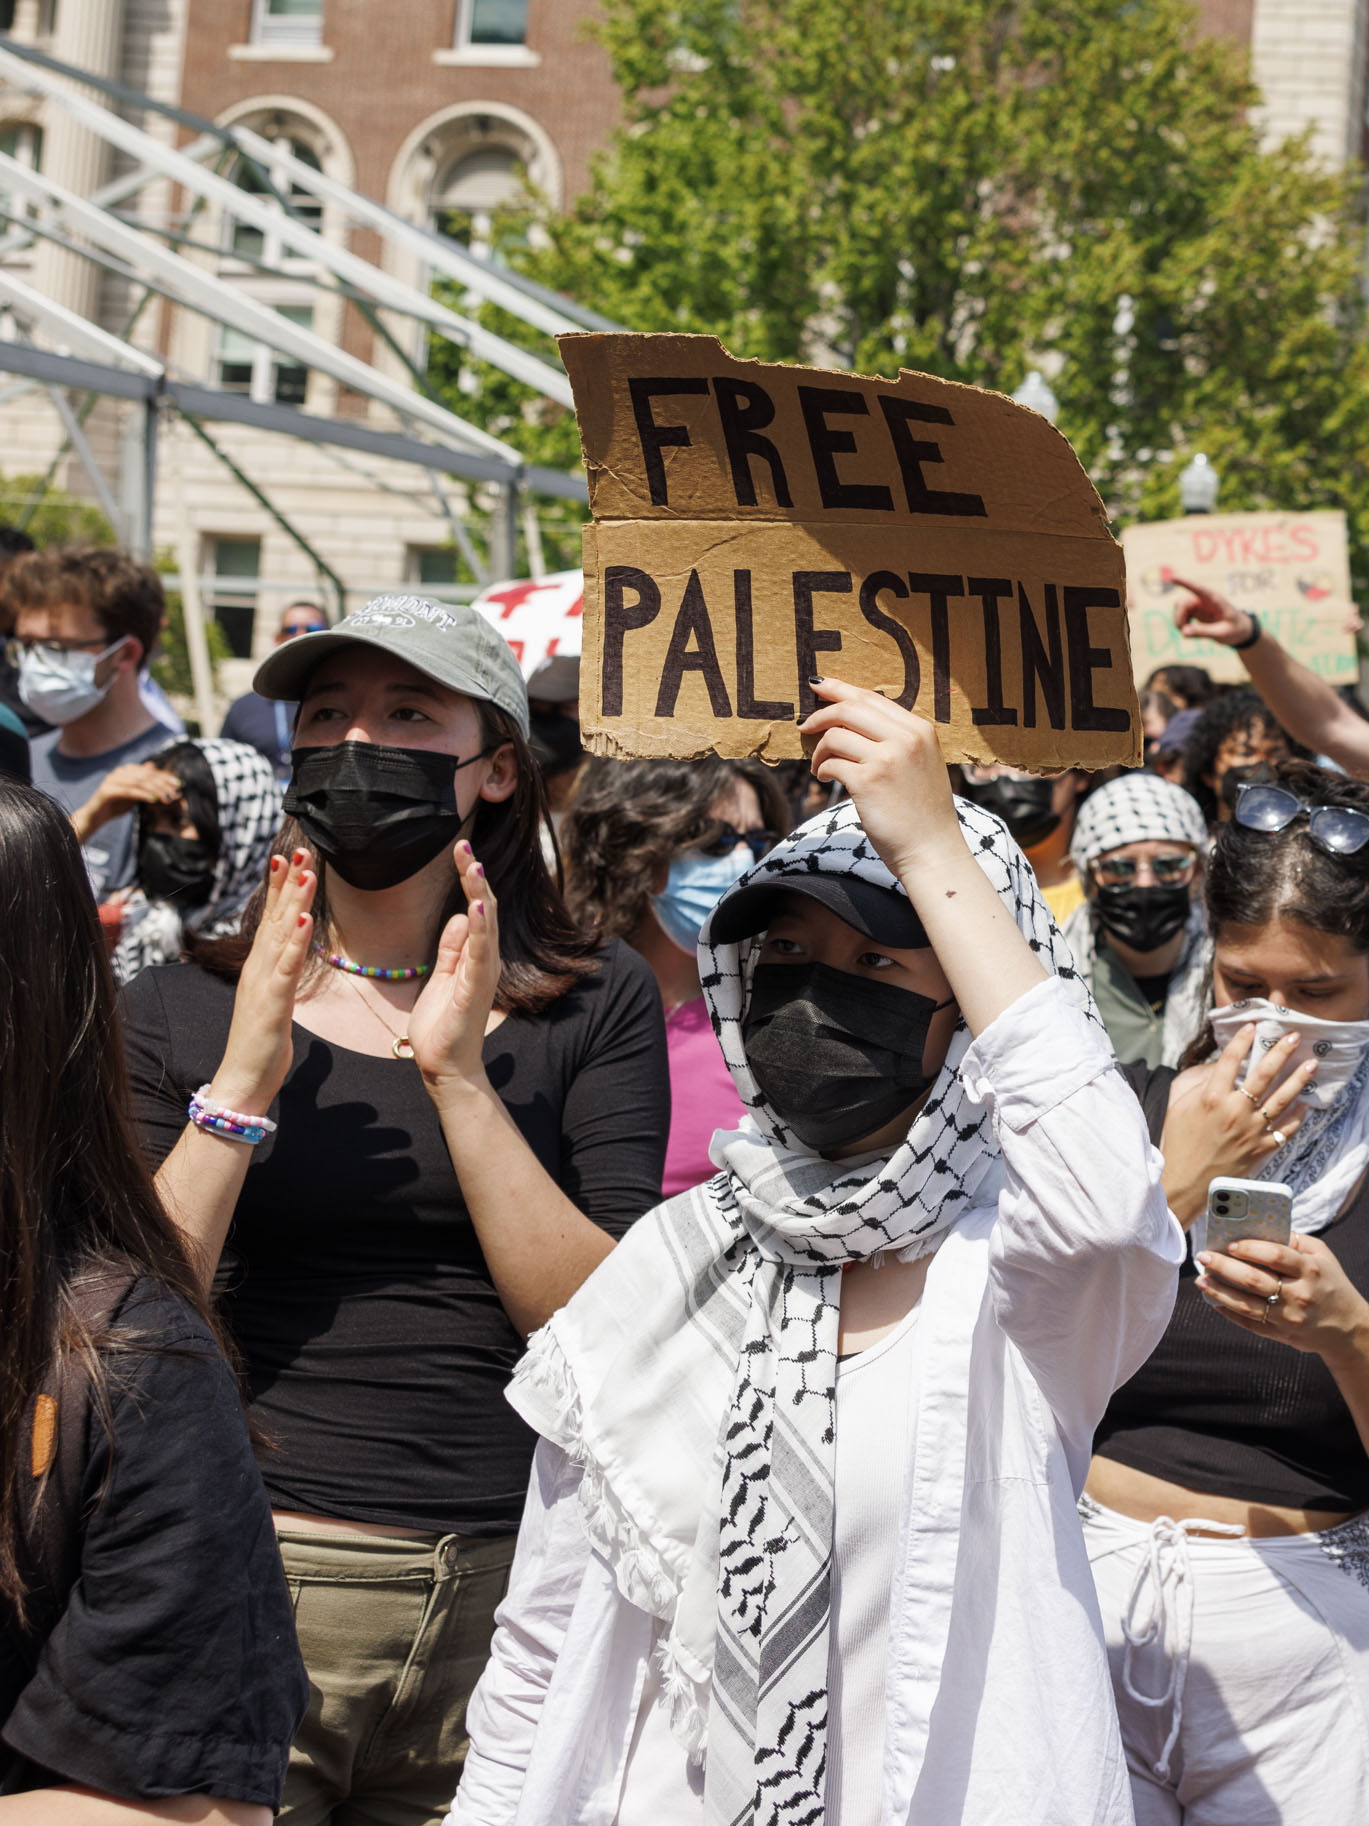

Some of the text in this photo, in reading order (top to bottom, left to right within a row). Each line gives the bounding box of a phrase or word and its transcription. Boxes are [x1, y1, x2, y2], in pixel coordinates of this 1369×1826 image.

[627, 376, 988, 517] FREE
[1190, 522, 1321, 565] DYKES
[601, 565, 1134, 732] PALESTINE
